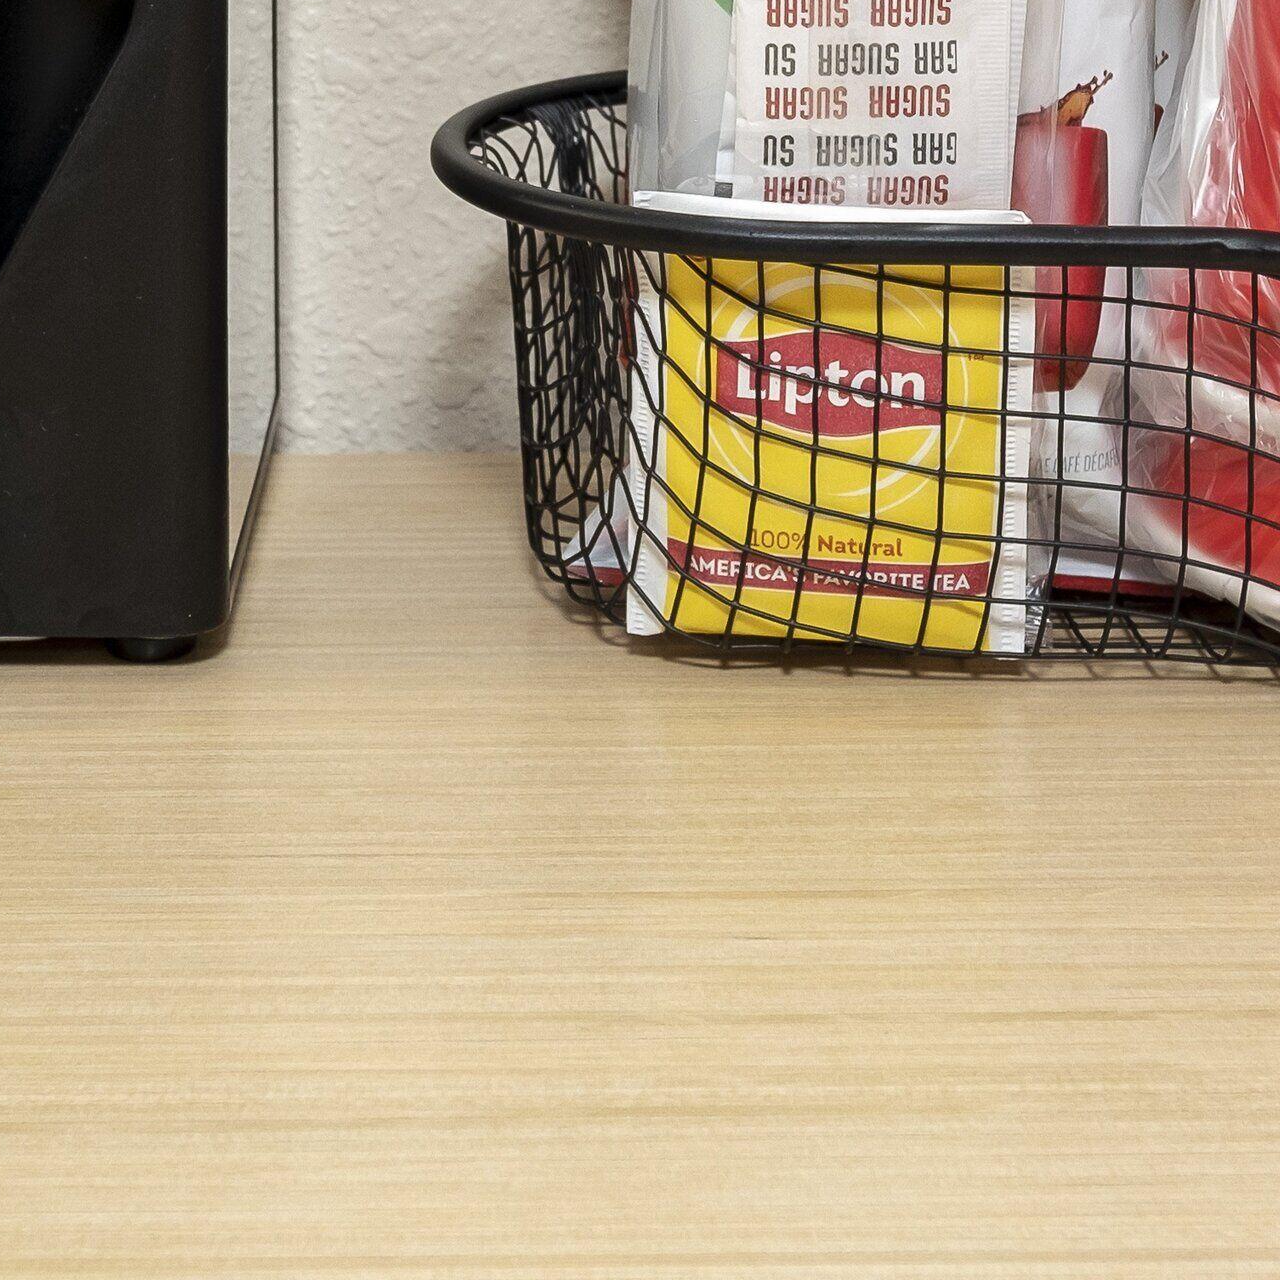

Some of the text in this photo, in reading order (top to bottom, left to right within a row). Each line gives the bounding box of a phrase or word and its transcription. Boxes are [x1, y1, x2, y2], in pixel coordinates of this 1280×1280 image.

[764, 40, 958, 77] GAR SUGAR SU
[765, 84, 951, 120] SUGAR SUGAR
[763, 132, 958, 168] GAR SUGAR SU
[763, 174, 950, 206] SUGAR SUGAR
[736, 351, 926, 415] Lipton
[750, 528, 807, 551] 100%
